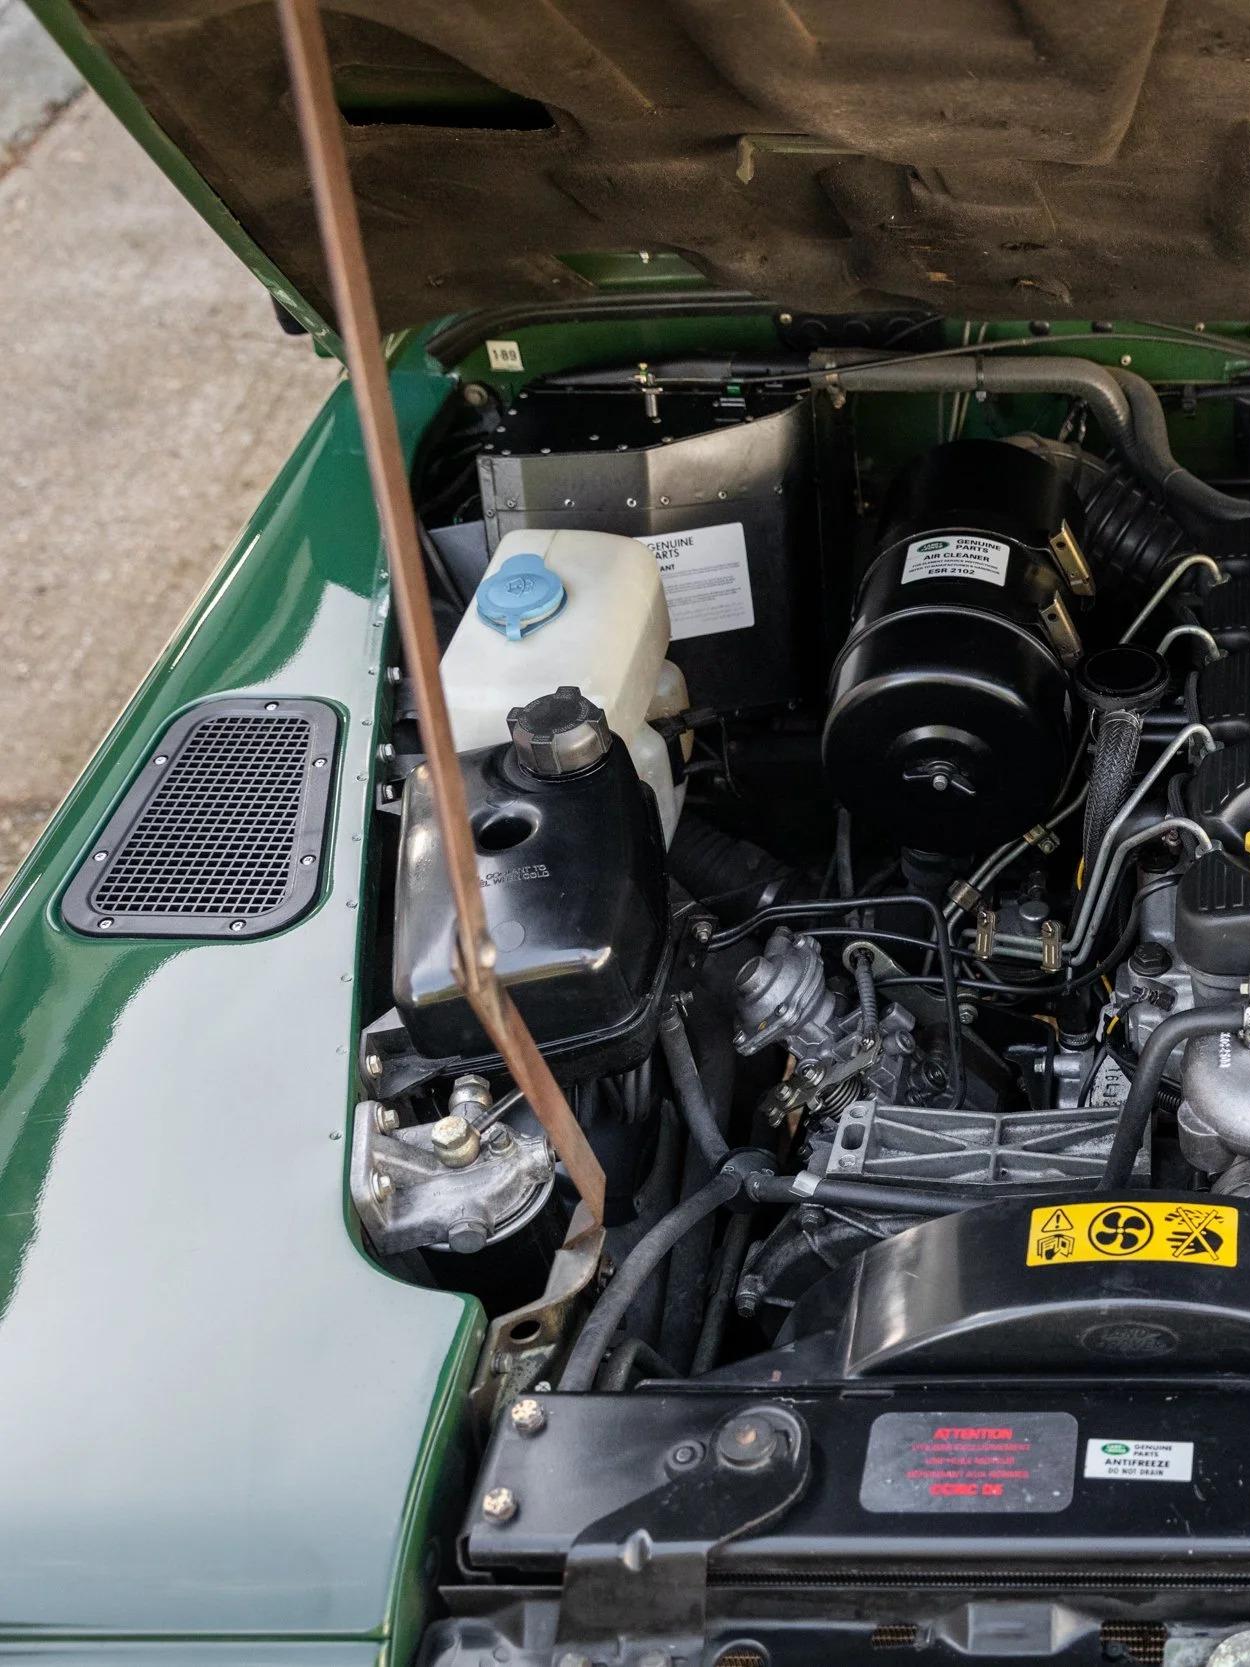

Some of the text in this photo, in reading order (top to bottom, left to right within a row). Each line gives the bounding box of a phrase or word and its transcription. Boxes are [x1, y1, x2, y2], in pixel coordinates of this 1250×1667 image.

[647, 536, 695, 552] GENUINE
[956, 539, 1001, 551] GENUINE
[956, 545, 989, 553] PARTS
[655, 549, 680, 560] ARTS
[923, 553, 990, 562] AIR CLEANER
[522, 870, 550, 880] COLD
[933, 1428, 1013, 1440] ATTENTION
[1134, 1444, 1173, 1452] GENUINE
[1105, 1458, 1170, 1468] ANTIFREEZE
[1108, 1467, 1164, 1477] DO NOT DRAIN
